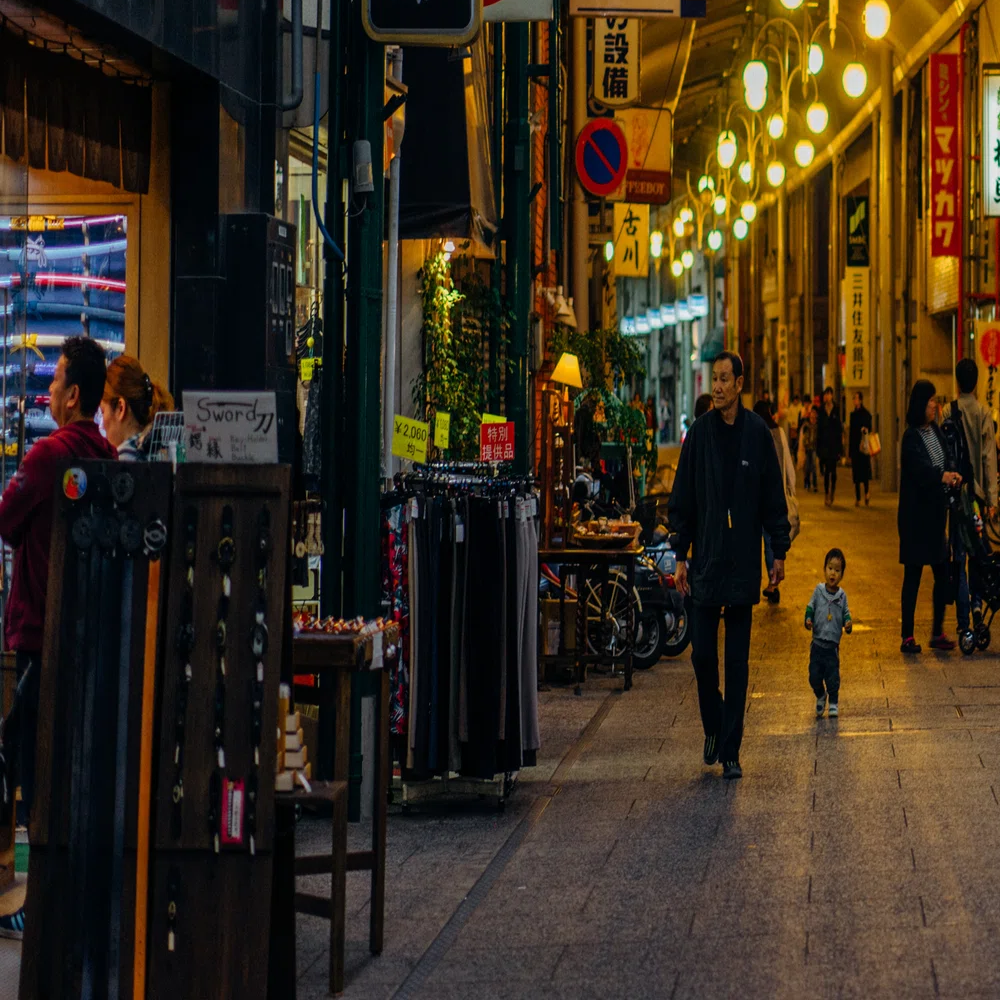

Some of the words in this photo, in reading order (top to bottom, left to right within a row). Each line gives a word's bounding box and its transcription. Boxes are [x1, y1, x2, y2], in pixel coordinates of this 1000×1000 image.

[934, 126, 954, 248] マツカワ
[622, 210, 641, 271] 古川
[852, 273, 864, 381] 三井住友銀行
[196, 397, 258, 422] Sword
[482, 443, 515, 461] 提供品
[487, 426, 509, 443] 特別
